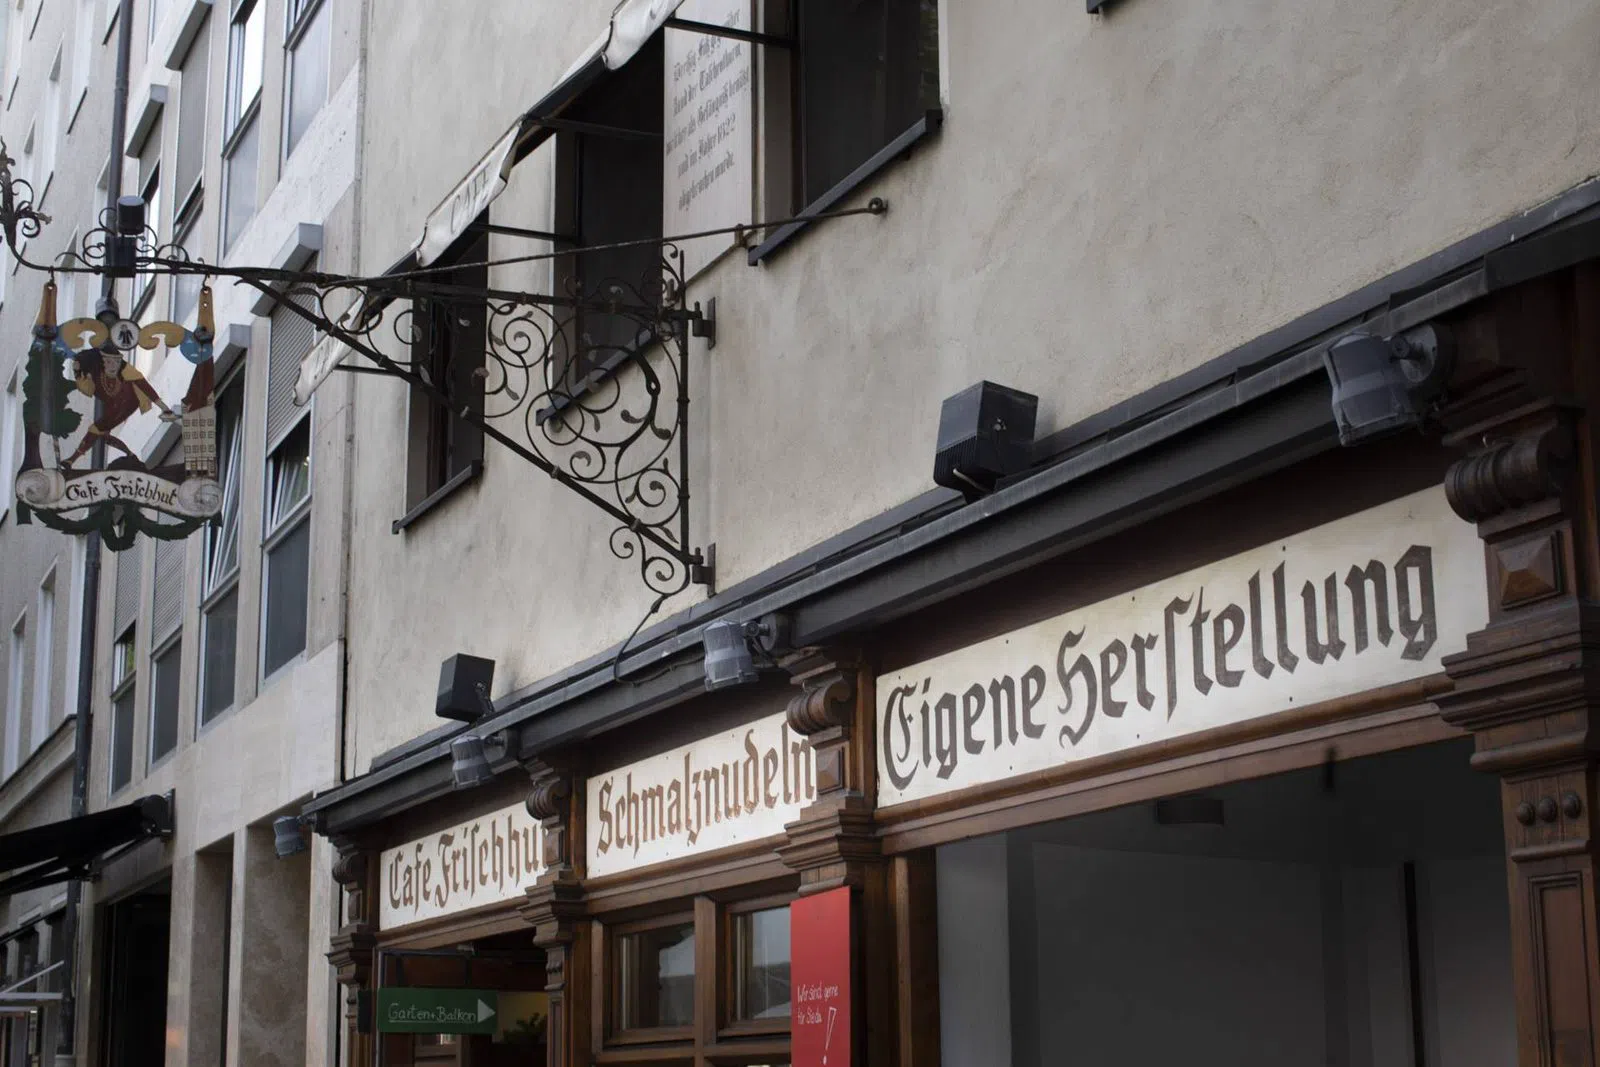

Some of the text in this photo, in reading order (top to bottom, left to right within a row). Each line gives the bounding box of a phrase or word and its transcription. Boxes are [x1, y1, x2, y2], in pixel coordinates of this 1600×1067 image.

[597, 721, 814, 859] Schmalznudeln
[883, 664, 1046, 790] Eigene
[389, 842, 431, 915] Cafe
